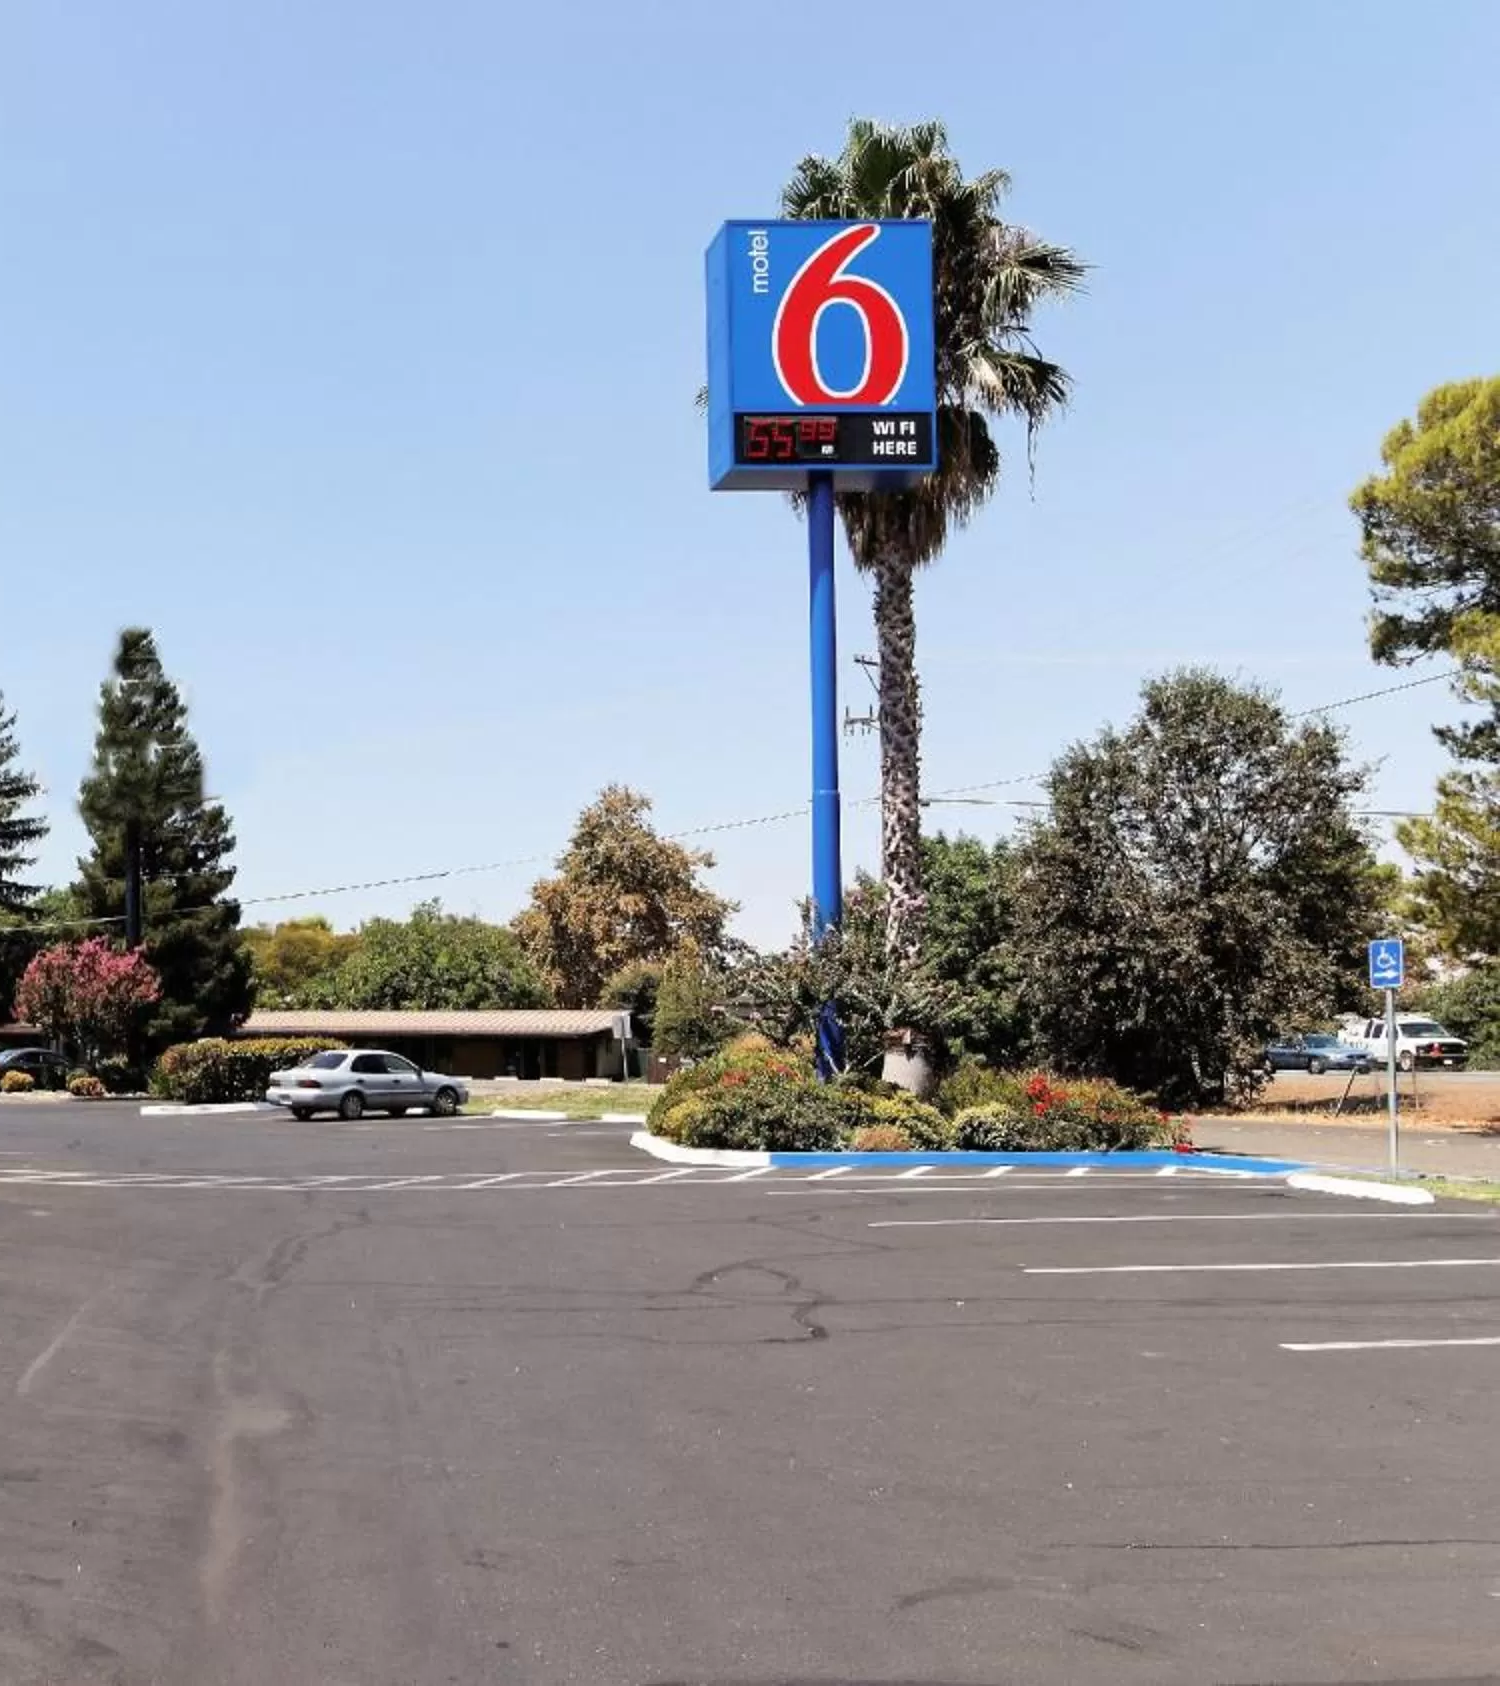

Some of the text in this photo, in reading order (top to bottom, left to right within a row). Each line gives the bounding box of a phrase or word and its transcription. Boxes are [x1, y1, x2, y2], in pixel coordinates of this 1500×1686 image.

[748, 223, 909, 406] motel 6
[872, 421, 915, 435] WI FI
[873, 441, 917, 455] HERE
